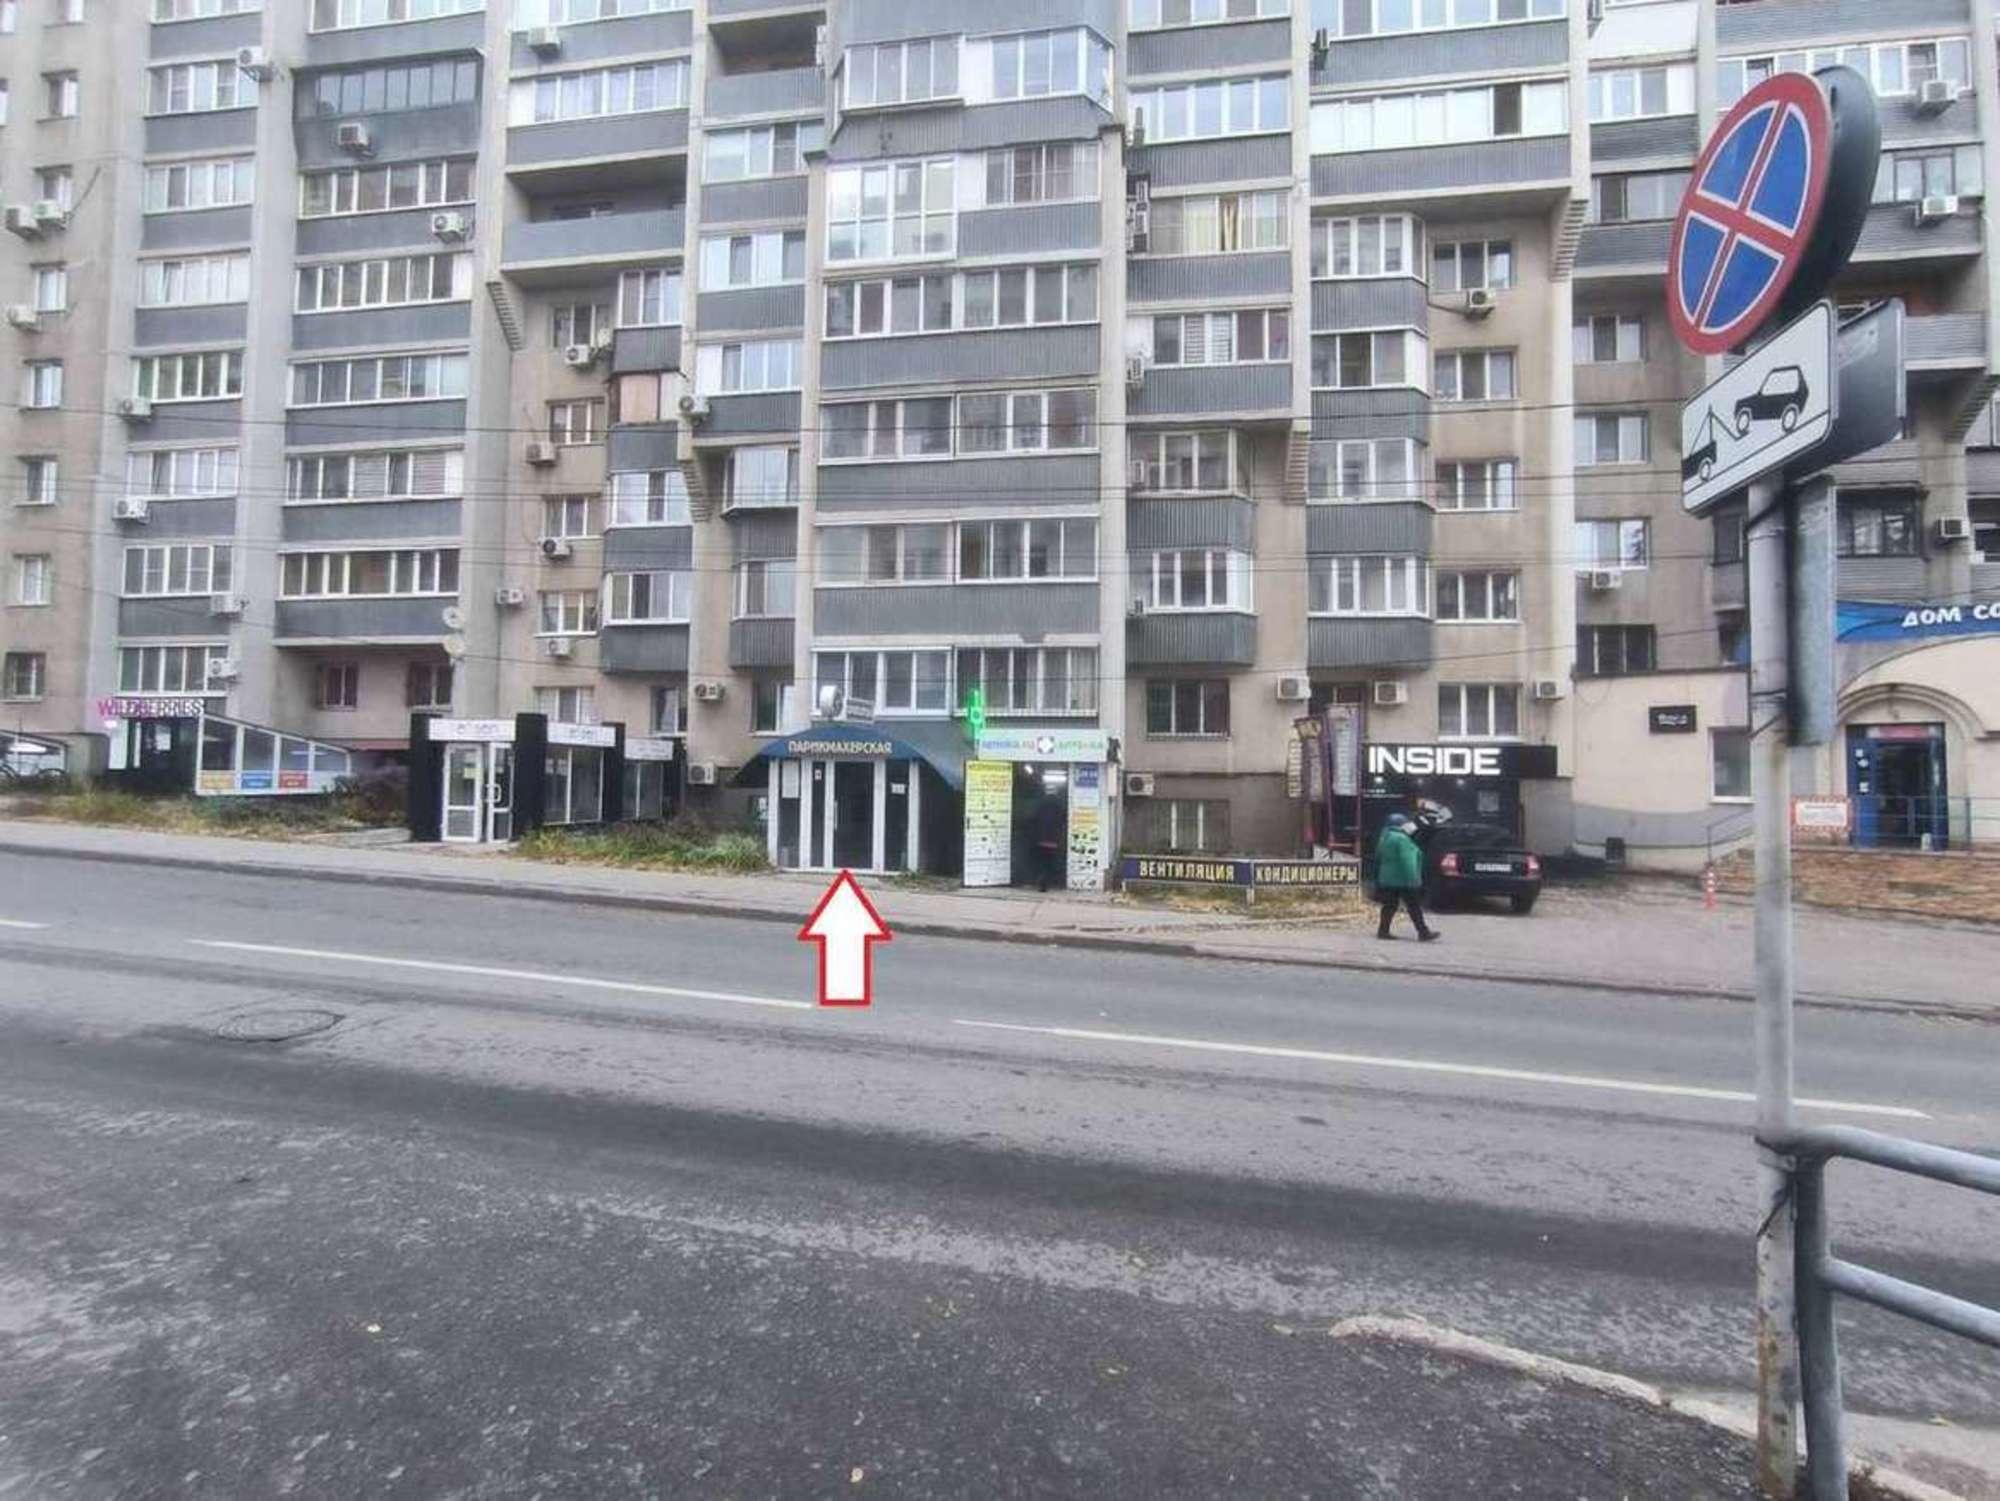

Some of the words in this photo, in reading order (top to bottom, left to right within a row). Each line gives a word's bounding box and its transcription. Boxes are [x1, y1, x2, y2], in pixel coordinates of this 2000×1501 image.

[1901, 606, 1961, 628] ДОМ
[788, 740, 893, 755] ПАРИКМАХЕРСКАЯ
[1368, 746, 1501, 775] INSIDE
[1139, 860, 1235, 880] ВЕНТИЛЯЦИЯ
[1255, 865, 1358, 883] КОНДИЦИОНЕРЫ
